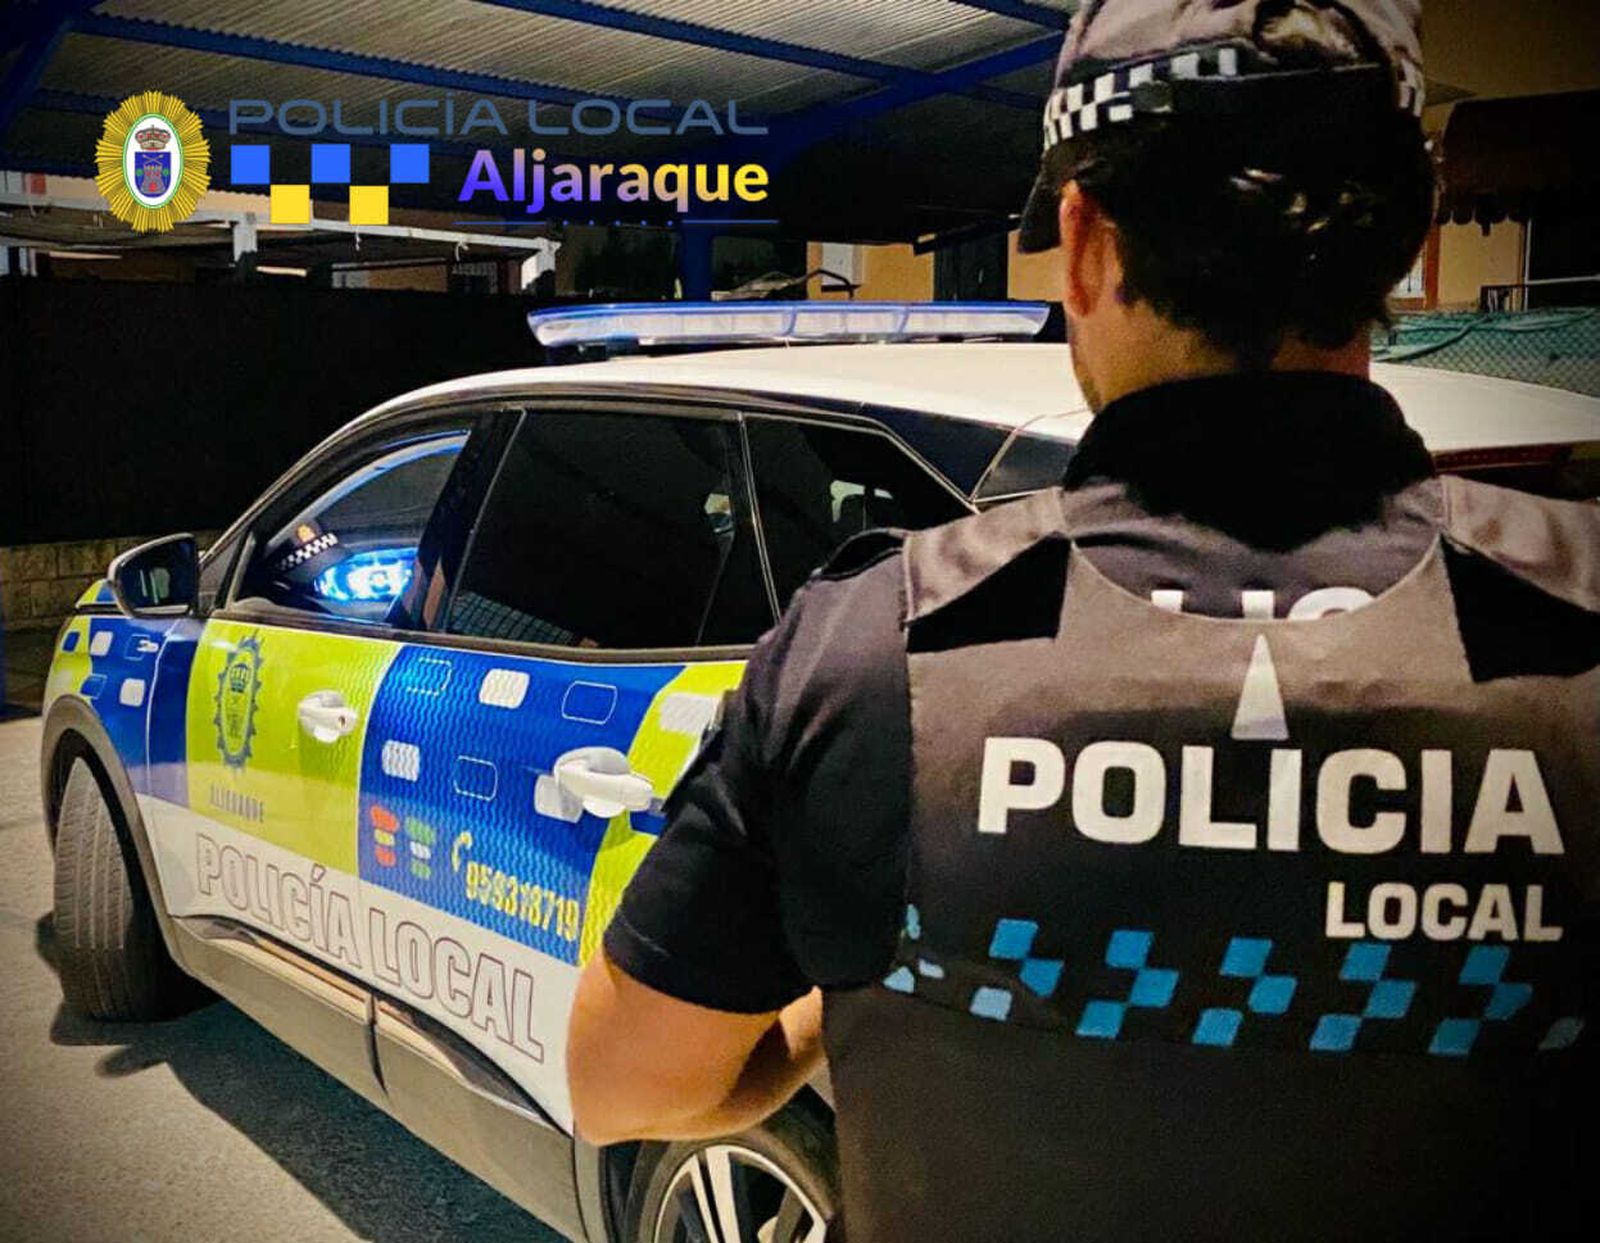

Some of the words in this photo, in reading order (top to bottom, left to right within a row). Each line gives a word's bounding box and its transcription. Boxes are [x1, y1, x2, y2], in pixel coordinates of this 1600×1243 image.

[978, 736, 1565, 855] POLICIA
[196, 833, 362, 966] POLICÍA
[369, 907, 544, 1062] LOCAL
[1325, 882, 1563, 942] LOCAL
